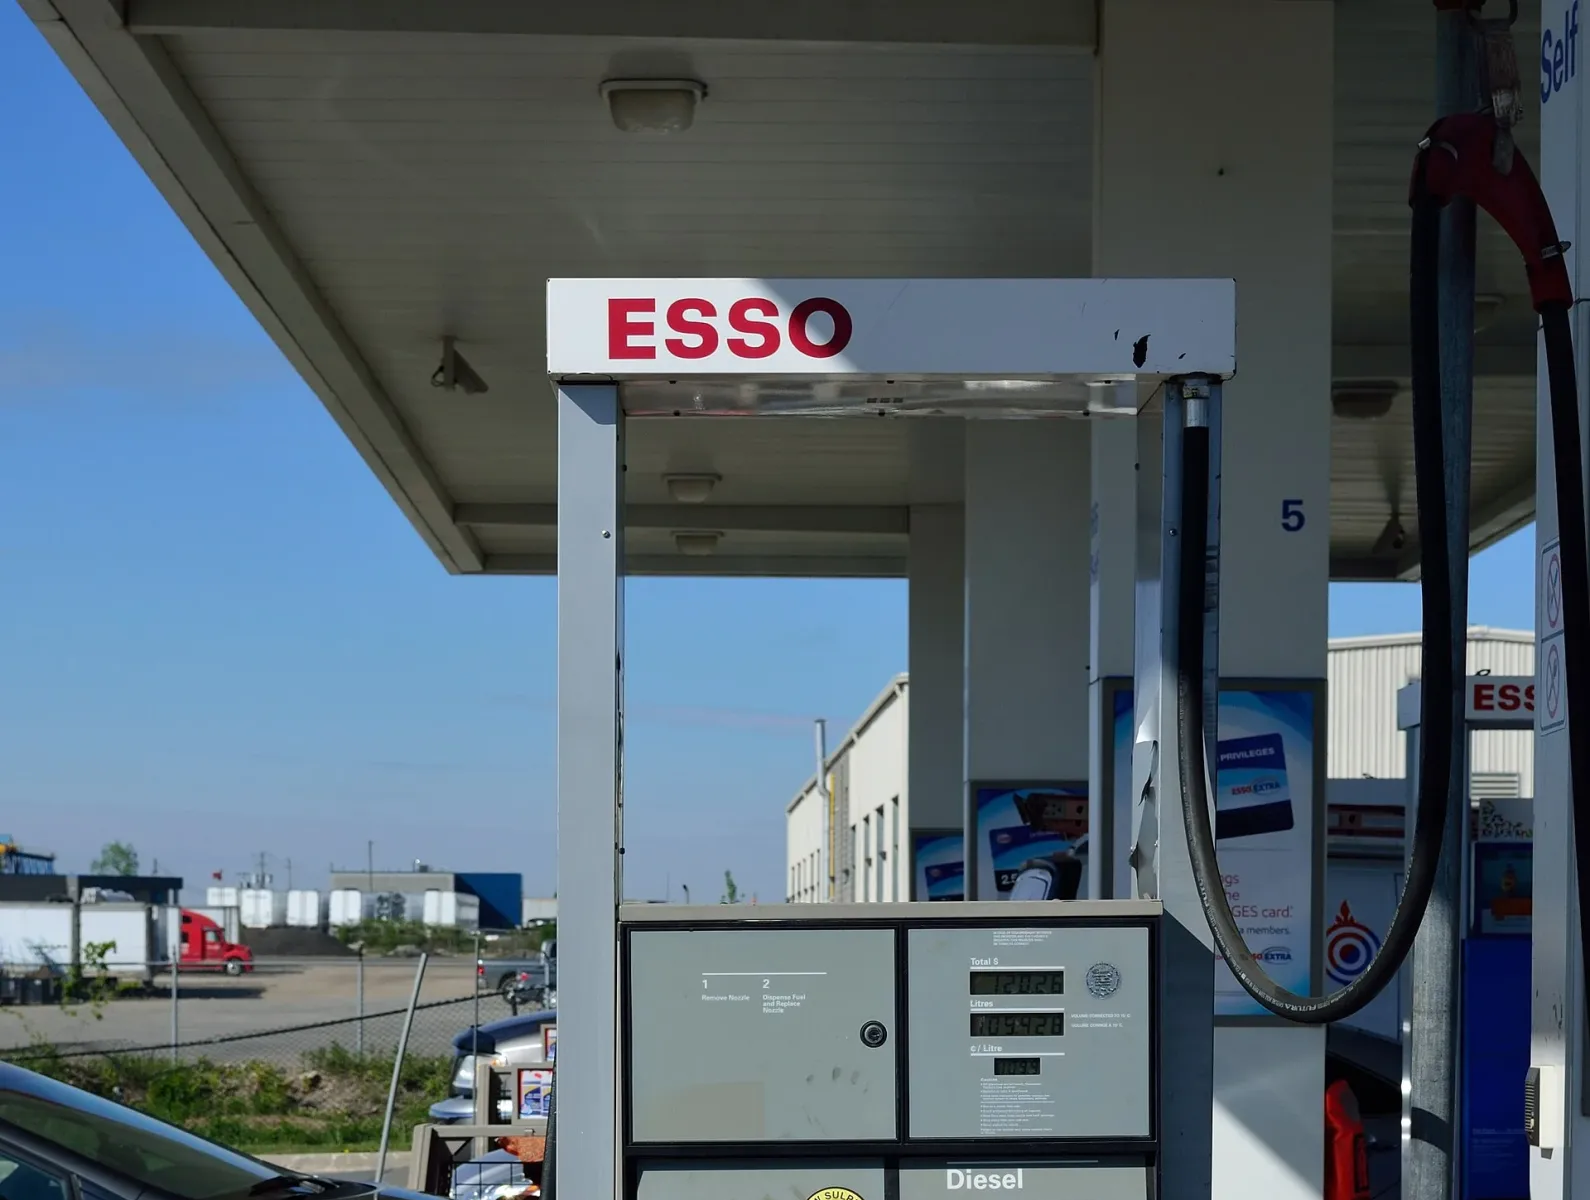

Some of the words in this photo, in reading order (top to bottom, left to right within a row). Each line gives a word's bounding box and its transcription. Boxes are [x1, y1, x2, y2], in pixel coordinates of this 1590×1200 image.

[1540, 0, 1579, 104] Self
[607, 297, 853, 359] ESSO
[1281, 499, 1305, 532] 5
[1474, 684, 1534, 711] ESS
[1220, 747, 1275, 761] PRIVILEGES
[1232, 905, 1258, 917] GES
[970, 957, 991, 966] Total
[702, 979, 708, 989] 1
[763, 979, 770, 989] 2
[762, 994, 791, 1002] Dispense
[983, 1044, 1002, 1052] Litre
[946, 1168, 1023, 1189] Diesel
